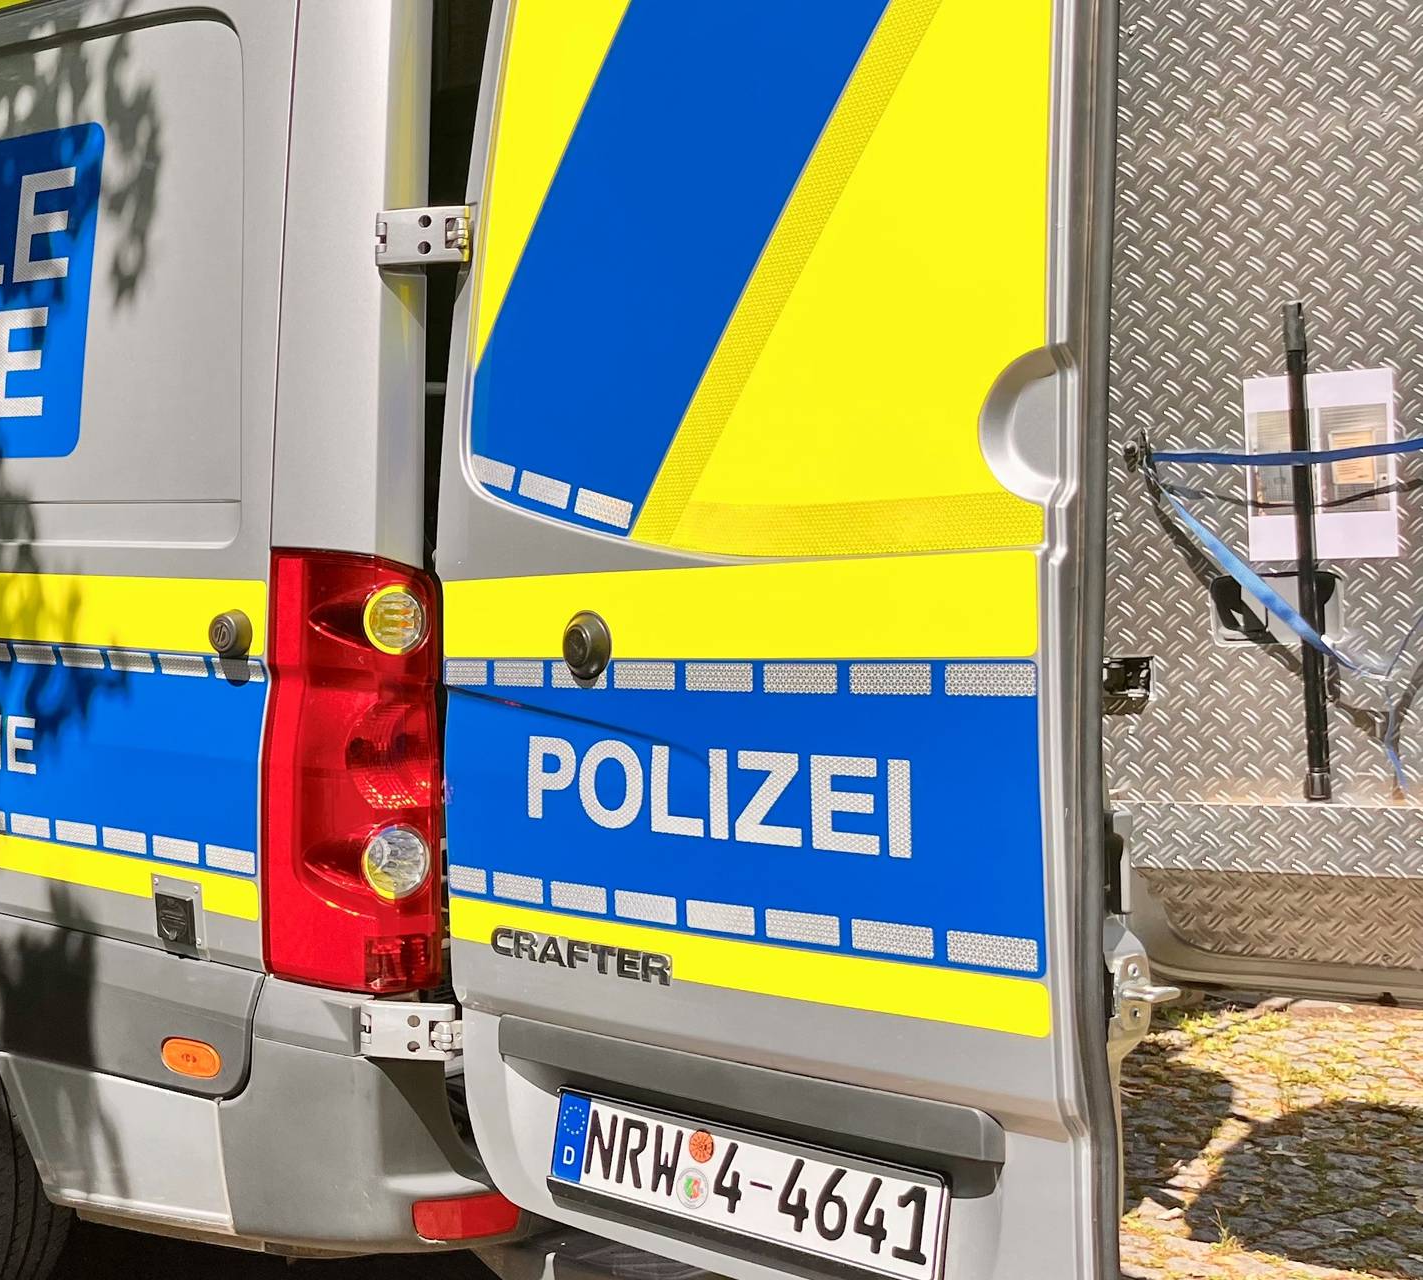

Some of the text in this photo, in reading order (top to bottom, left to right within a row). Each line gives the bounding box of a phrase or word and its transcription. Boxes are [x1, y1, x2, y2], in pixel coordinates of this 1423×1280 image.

[526, 735, 913, 859] POLIZEI
[490, 925, 673, 986] CRAFTER
[562, 1145, 575, 1166] D
[584, 1109, 684, 1197] NRW
[712, 1141, 928, 1266] 4-4641
